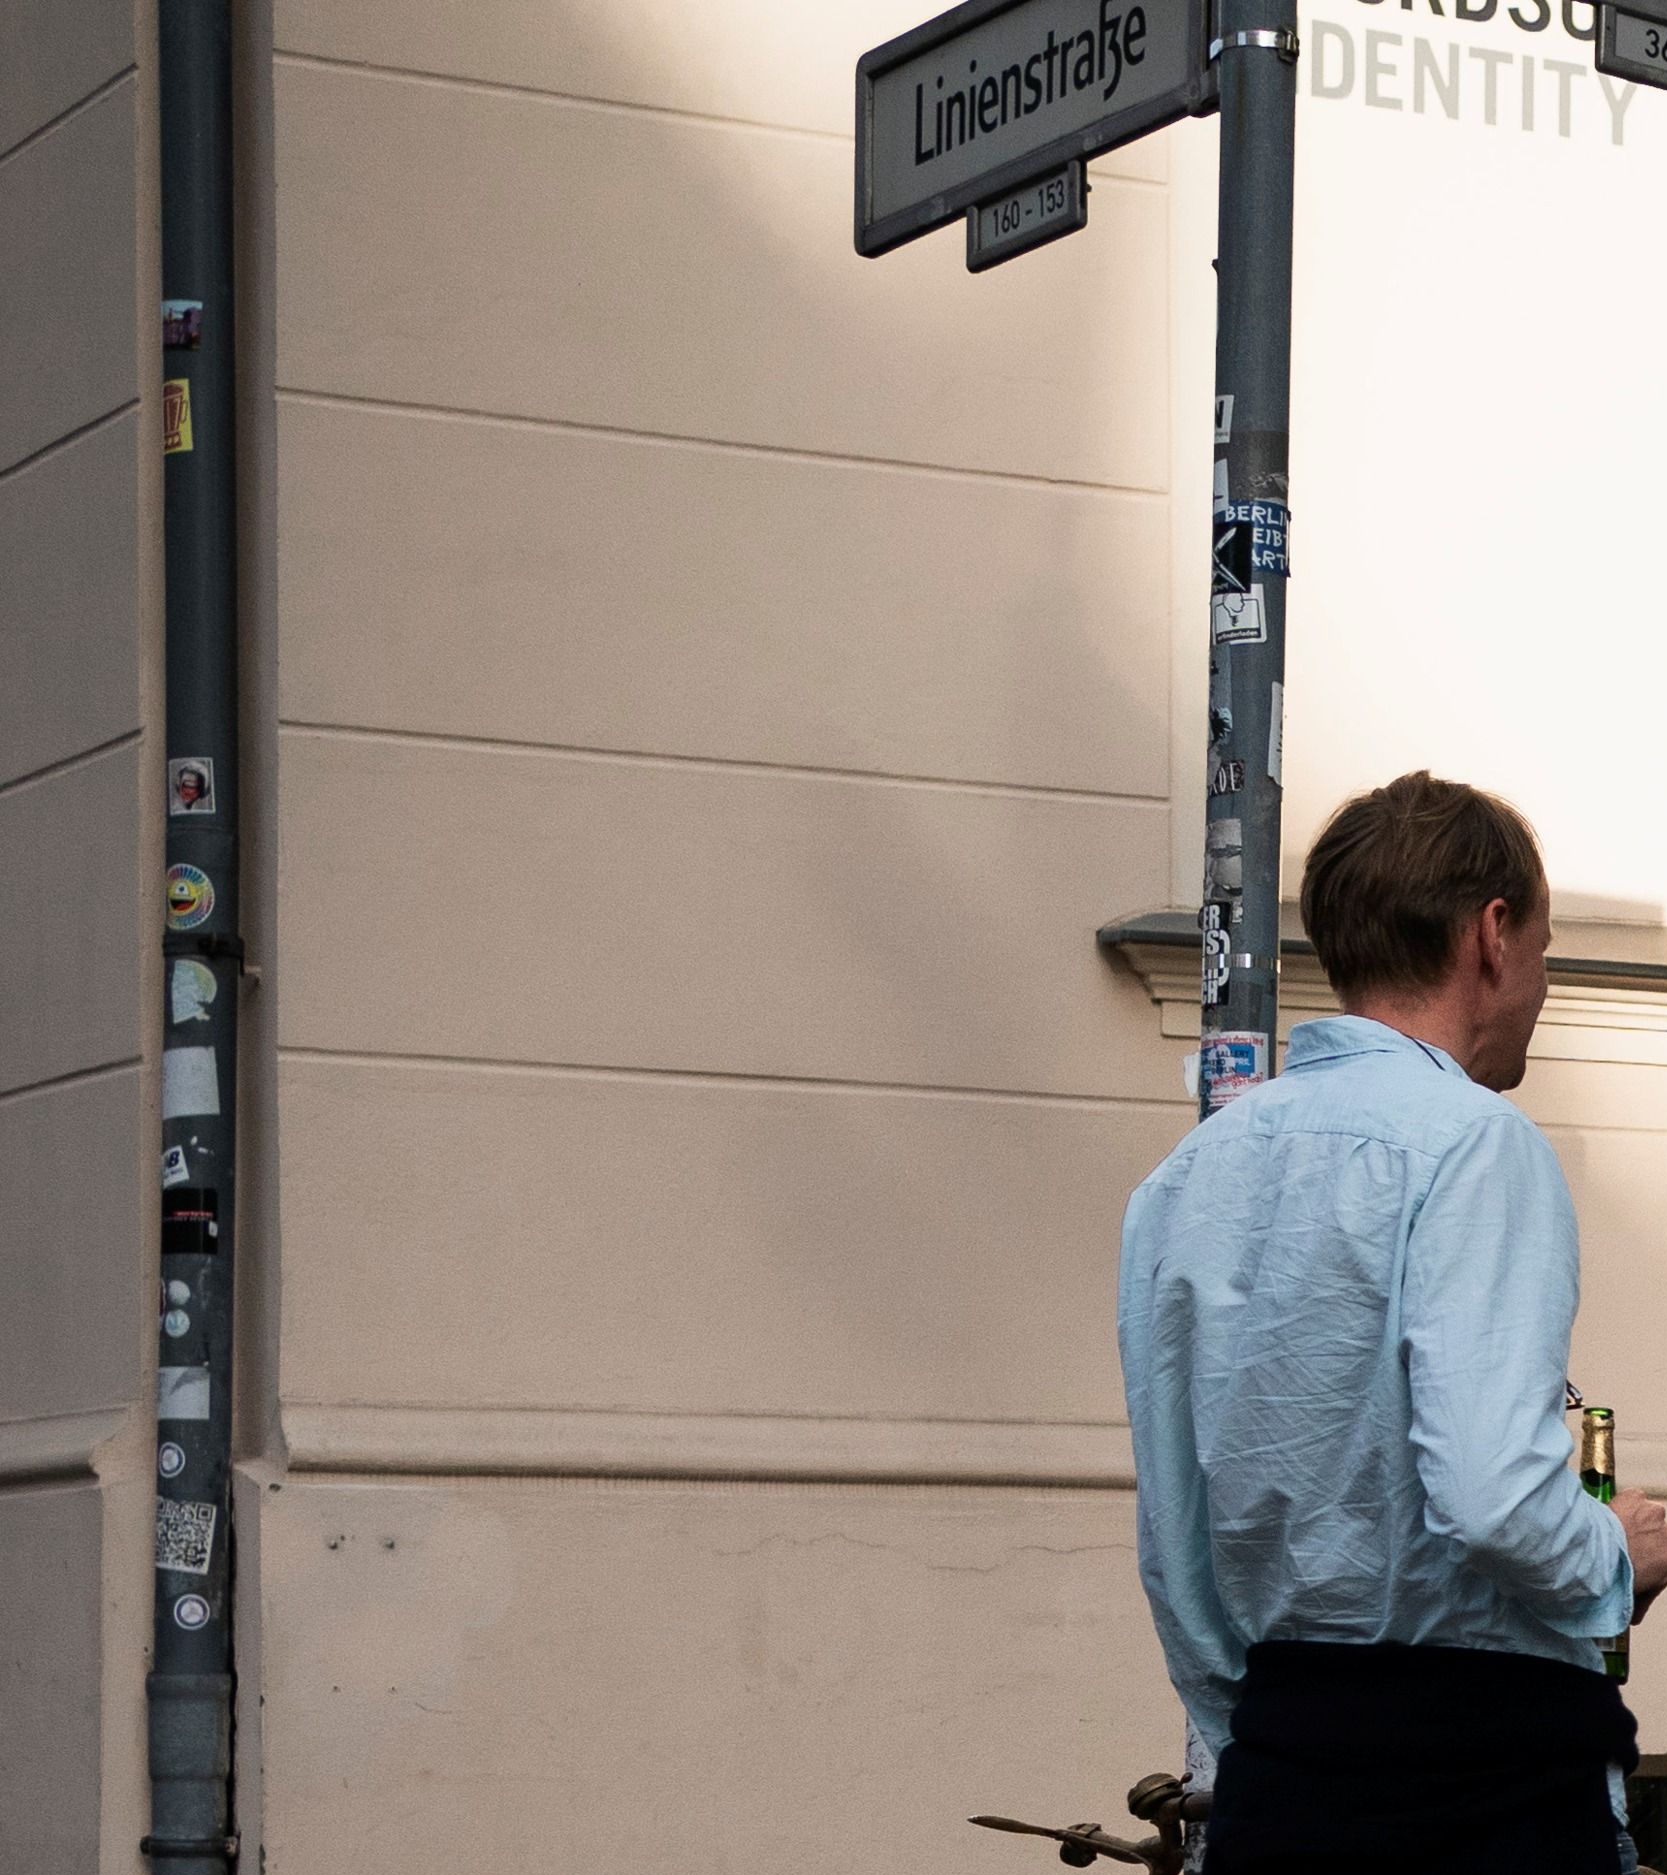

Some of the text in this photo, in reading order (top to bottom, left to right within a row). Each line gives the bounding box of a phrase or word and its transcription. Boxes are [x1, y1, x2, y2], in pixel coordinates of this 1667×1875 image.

[915, 0, 1146, 166] Linienstraße
[1297, 19, 1637, 147] DENTITY
[993, 199, 1021, 238] 160
[1038, 179, 1065, 218] 153
